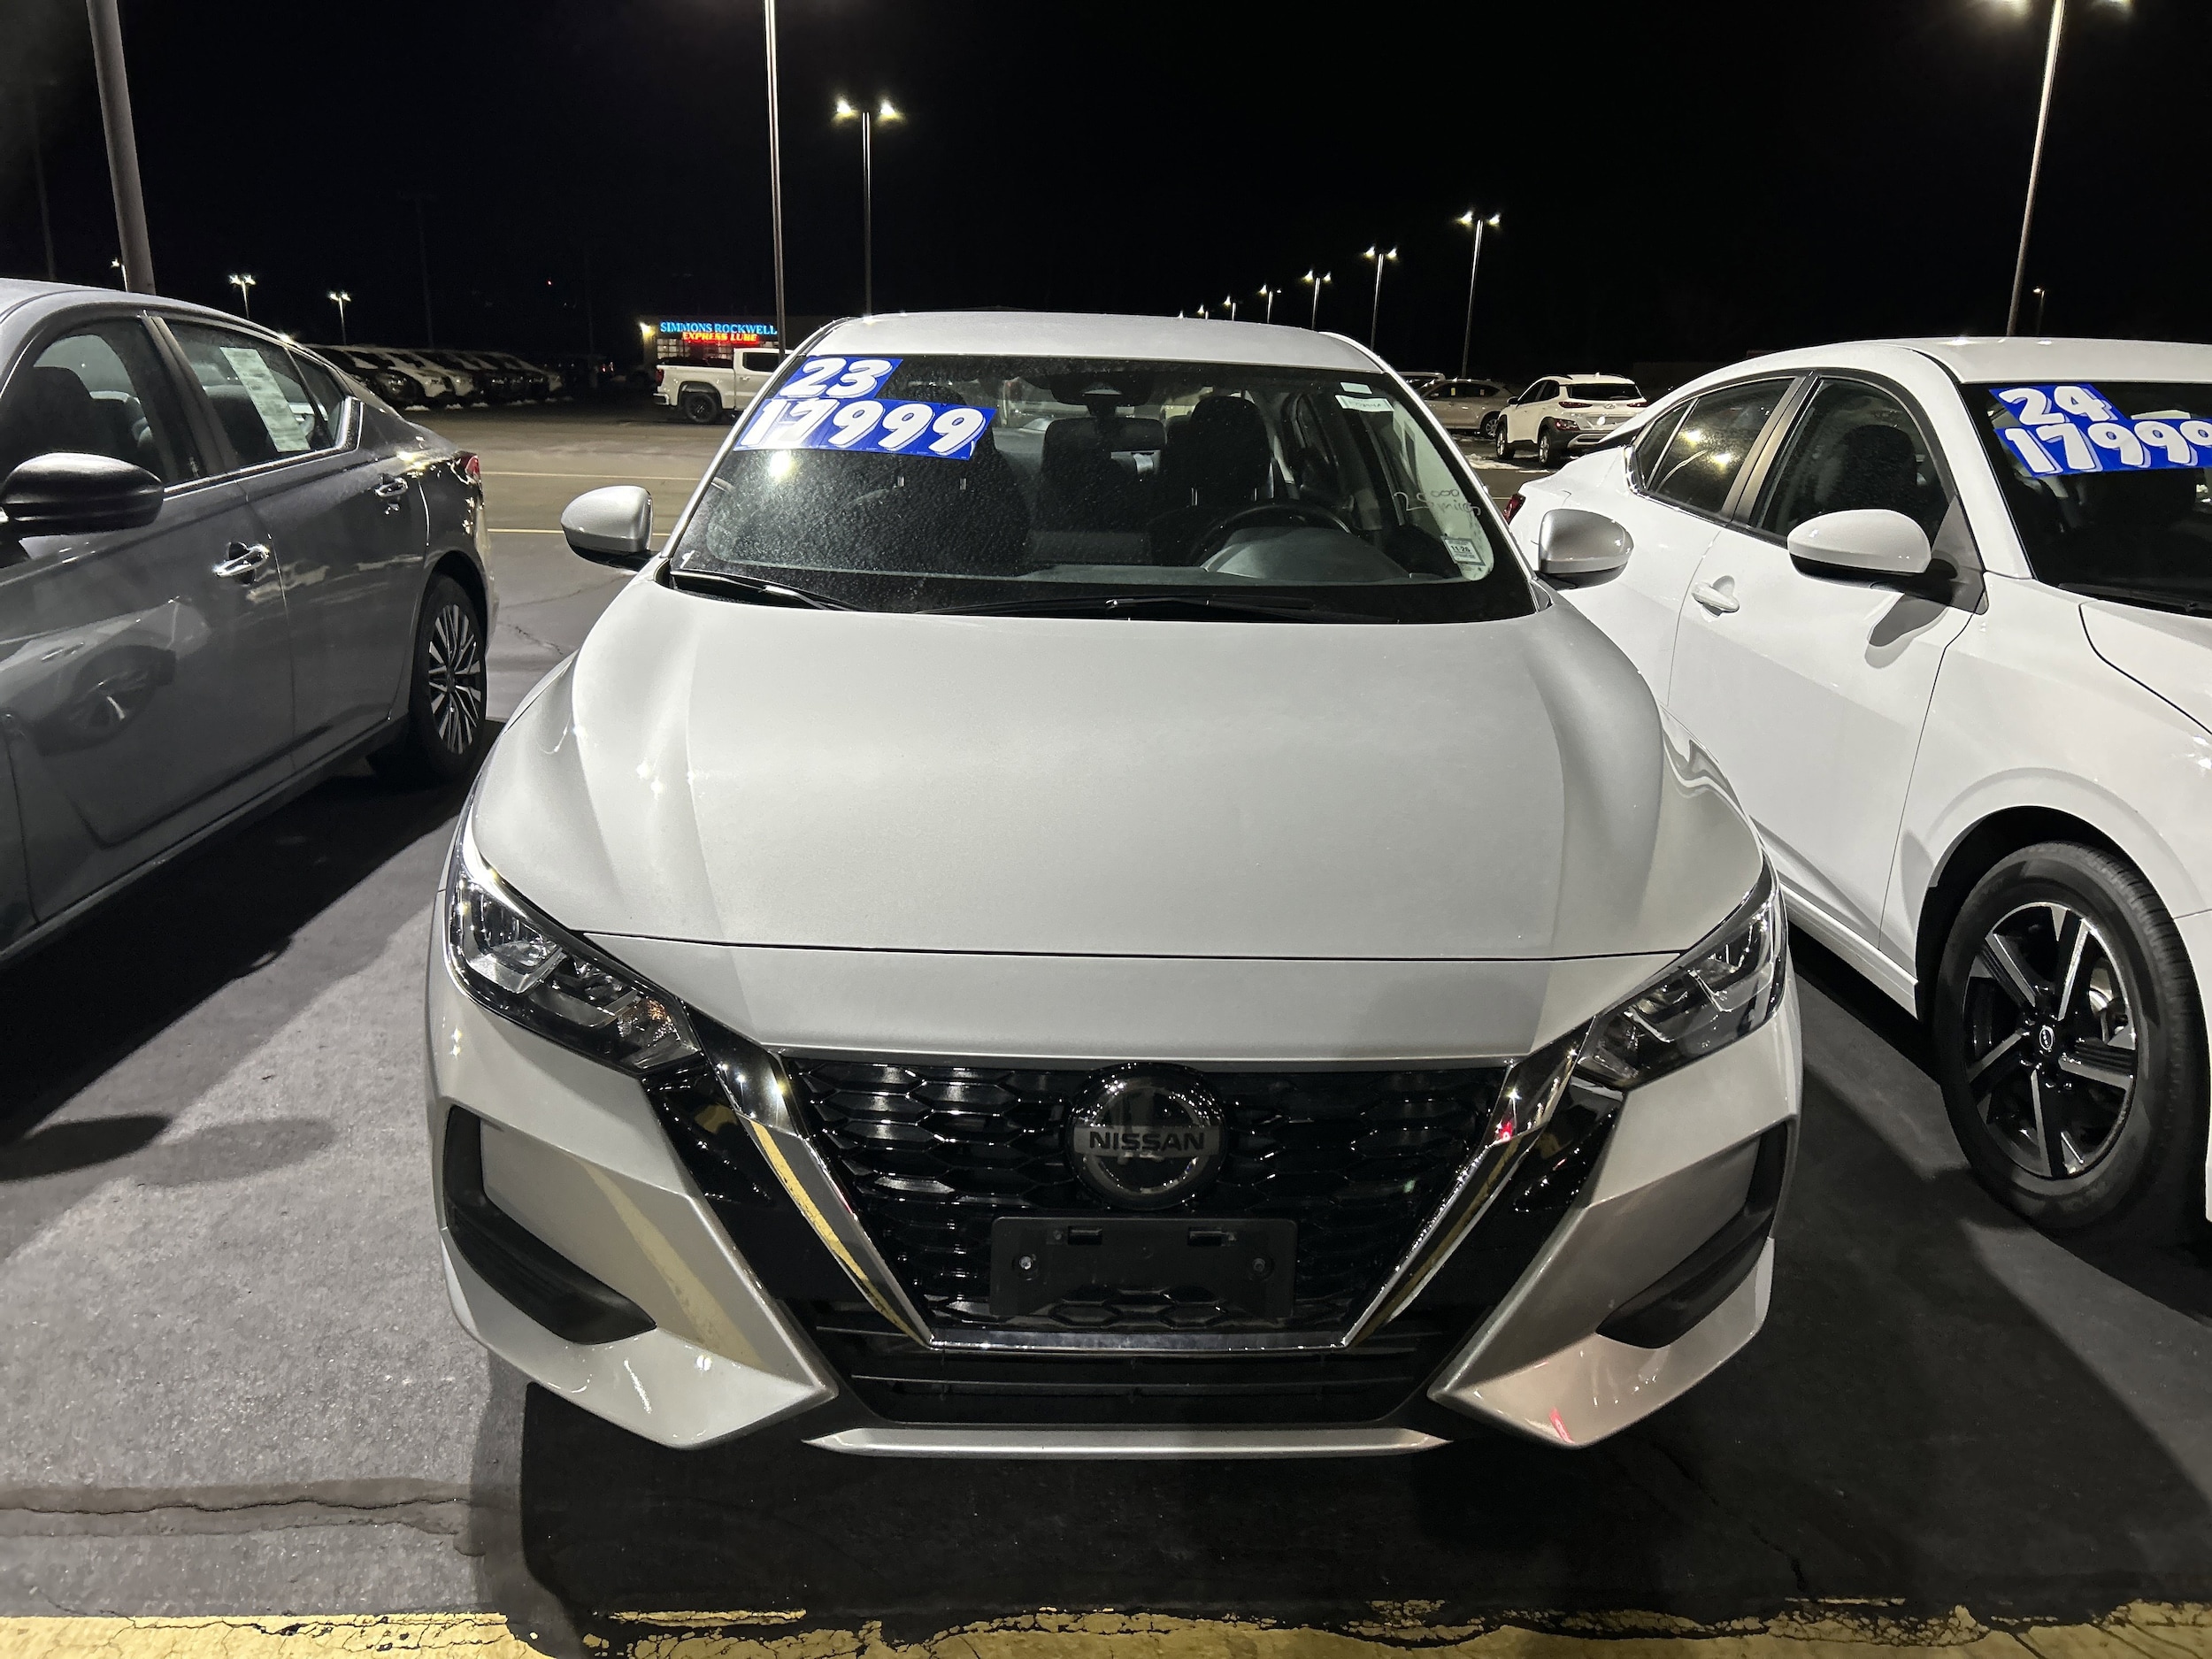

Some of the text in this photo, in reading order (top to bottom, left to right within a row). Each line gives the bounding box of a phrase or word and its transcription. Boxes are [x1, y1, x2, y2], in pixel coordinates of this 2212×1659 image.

[660, 322, 778, 334] SIMMONS ROCKWELL
[682, 332, 757, 342] EXPRESS LUBE
[780, 357, 893, 399] 23
[1998, 386, 2118, 425] 24
[740, 397, 986, 457] 17999
[1089, 1131, 1205, 1151] NISSAN
